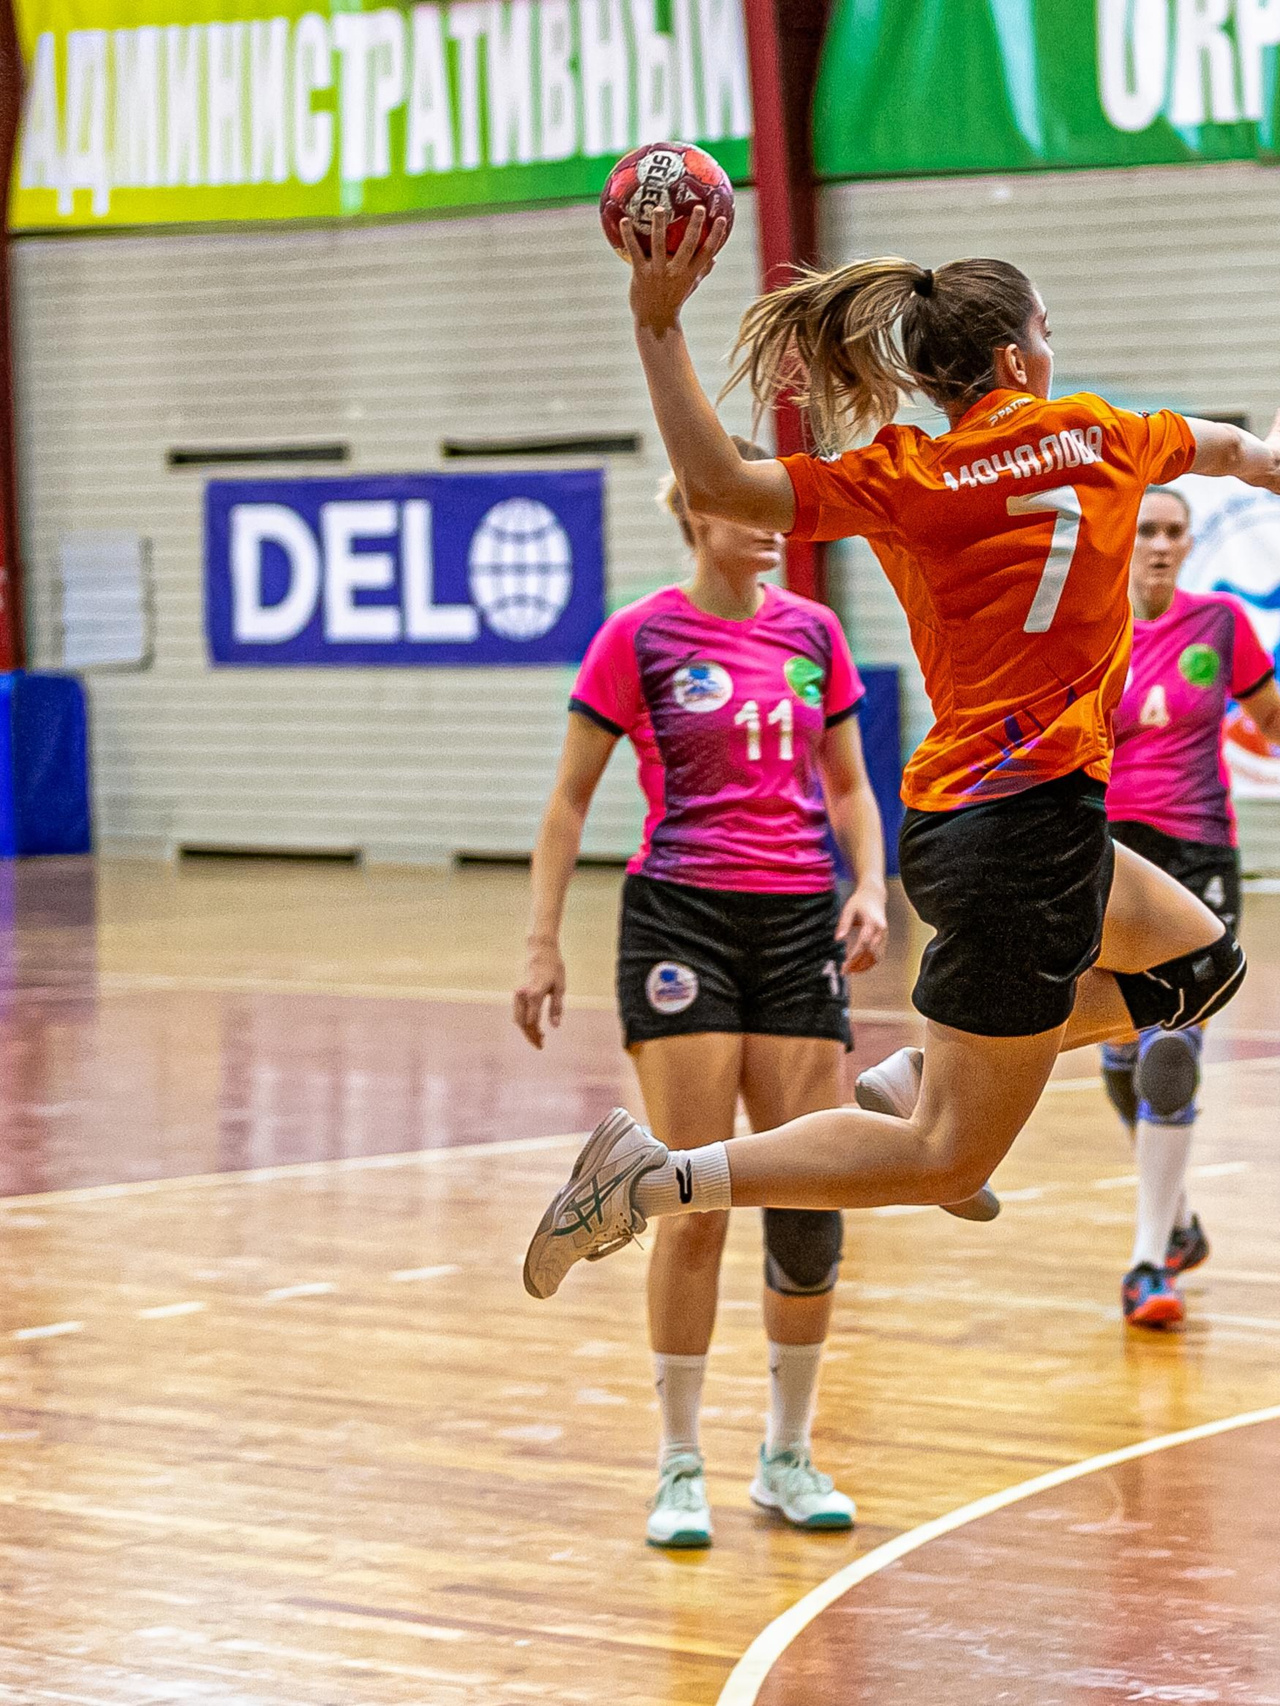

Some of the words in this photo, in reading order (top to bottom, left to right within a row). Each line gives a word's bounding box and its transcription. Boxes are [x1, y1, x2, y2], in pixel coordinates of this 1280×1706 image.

[1006, 484, 1083, 633] 7
[734, 698, 794, 761] 11
[1139, 684, 1170, 728] 4
